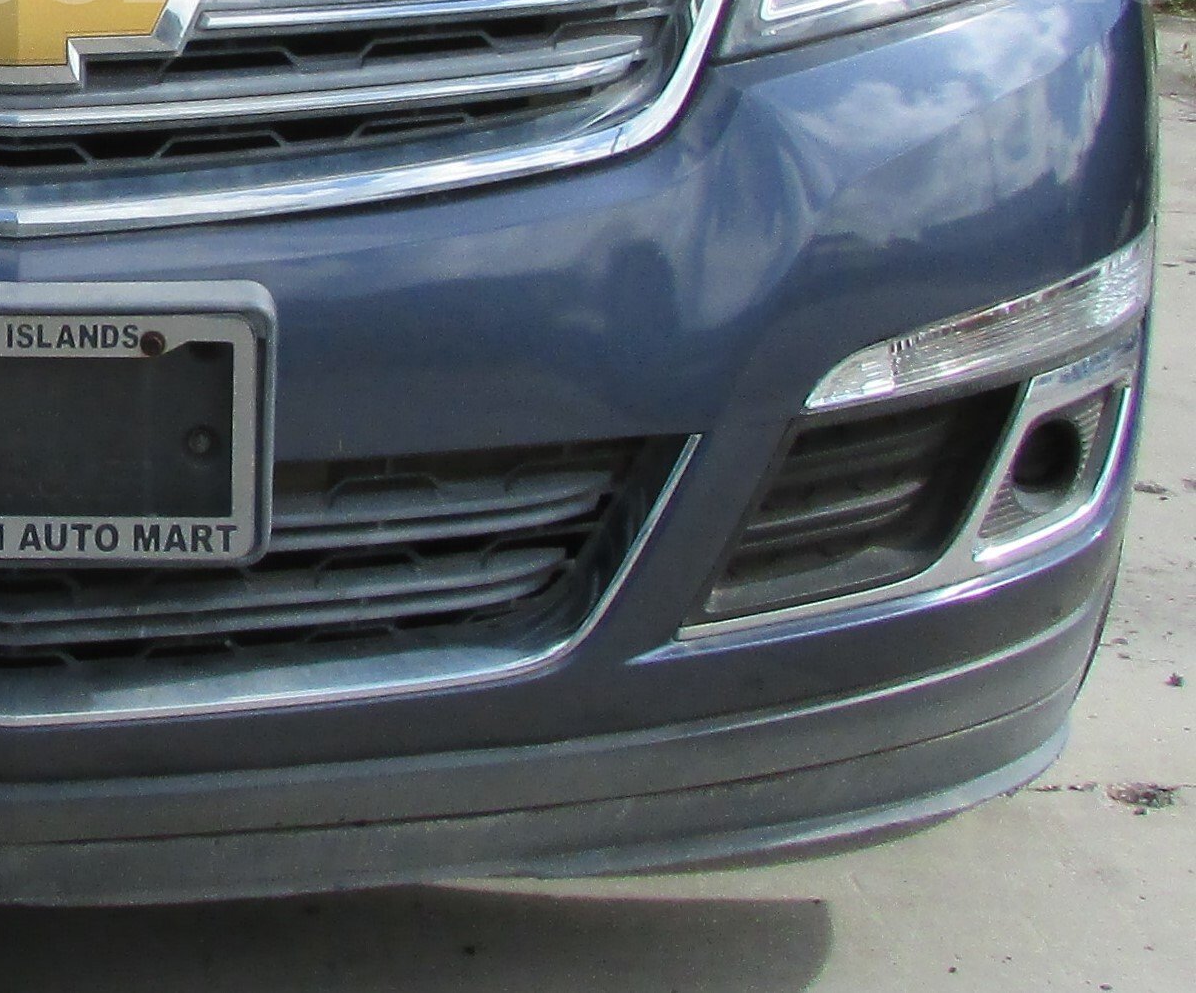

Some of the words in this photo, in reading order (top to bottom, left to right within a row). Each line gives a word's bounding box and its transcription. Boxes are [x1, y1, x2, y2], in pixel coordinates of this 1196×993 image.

[6, 324, 140, 349] ISLANDS
[18, 523, 120, 552] AUTO
[132, 524, 238, 553] MART
